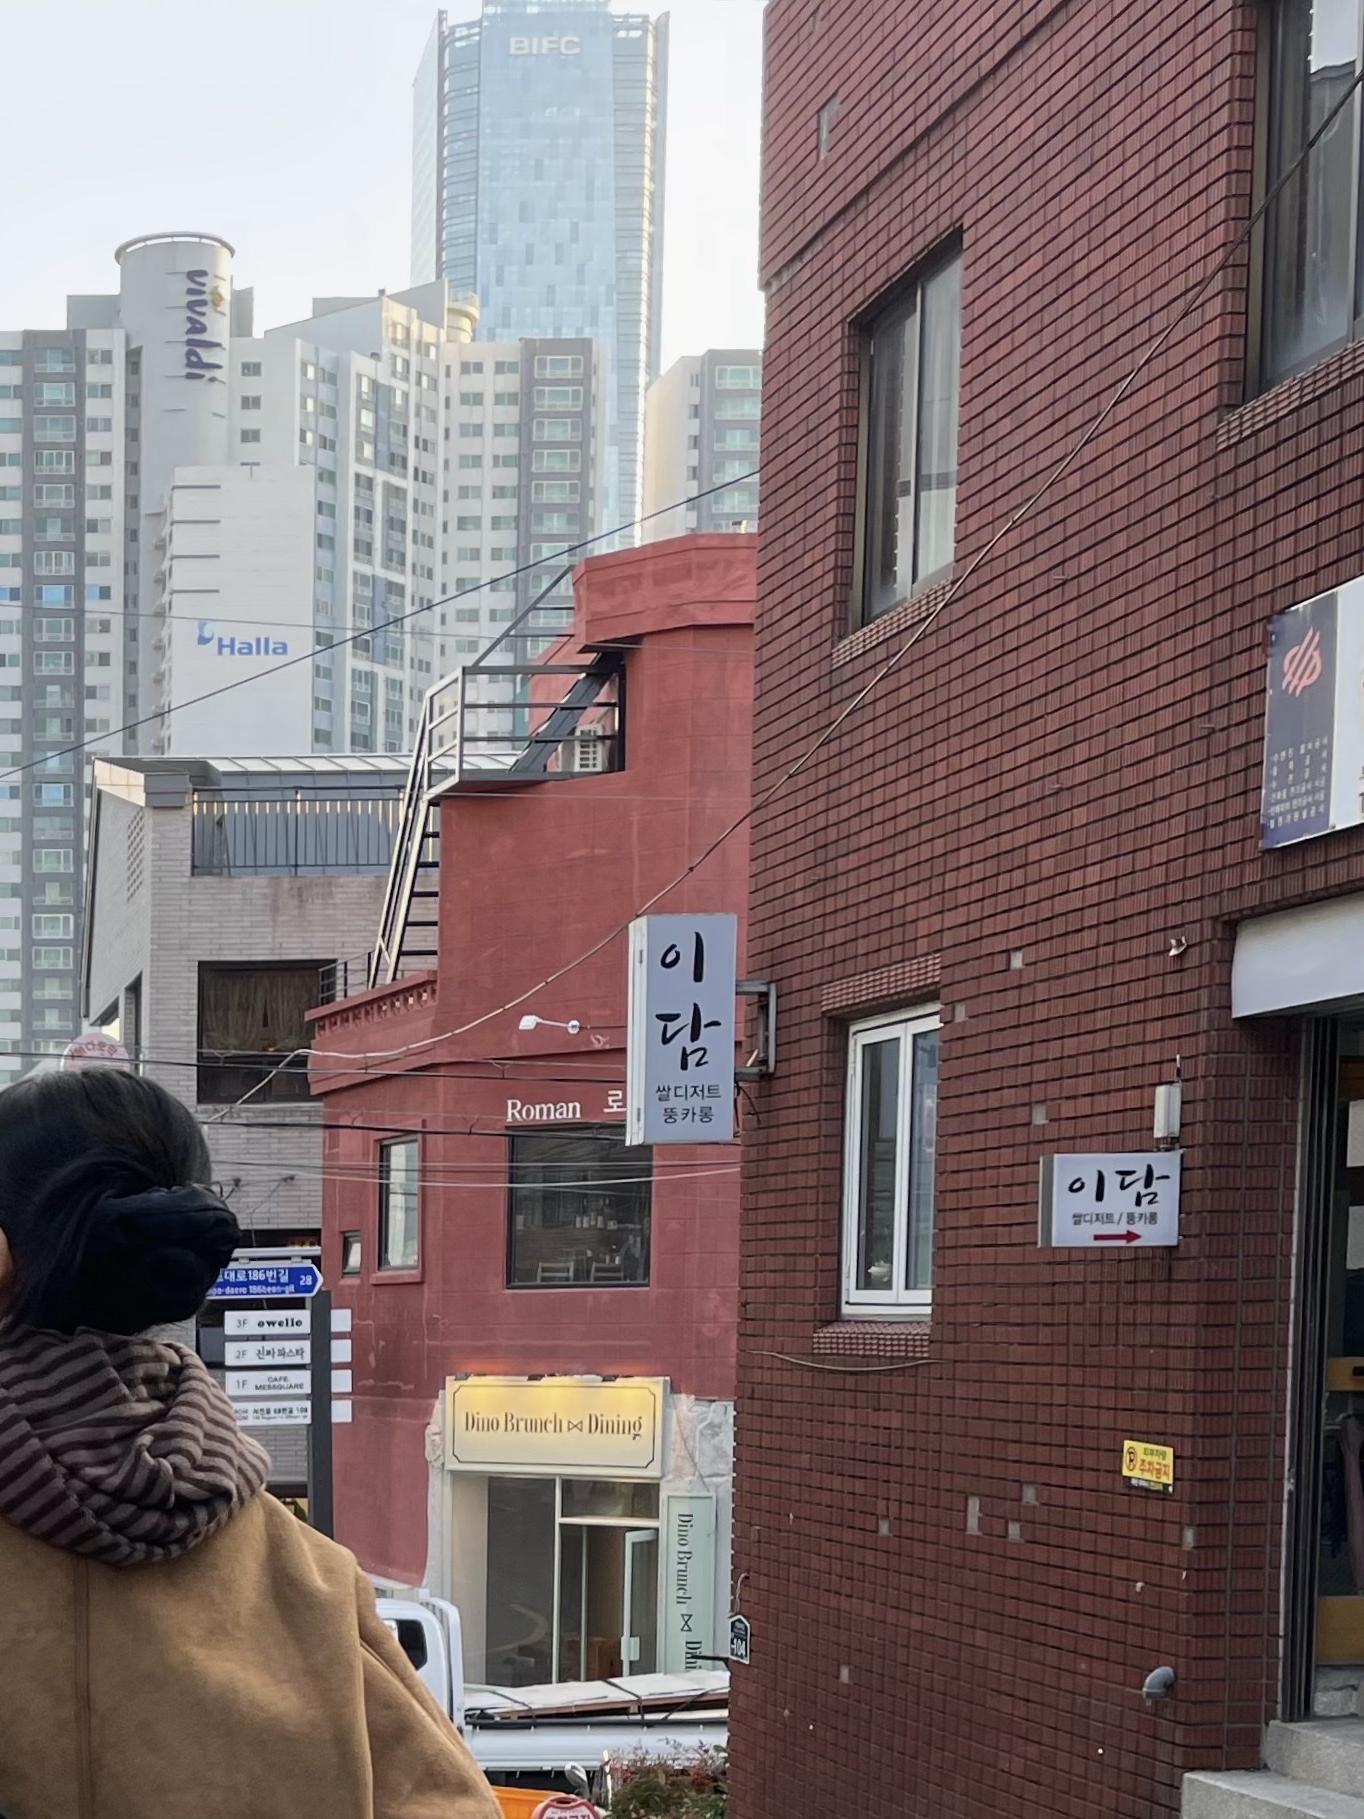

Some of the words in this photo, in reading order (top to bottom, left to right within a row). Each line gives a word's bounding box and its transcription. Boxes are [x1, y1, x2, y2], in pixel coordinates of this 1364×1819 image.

[509, 35, 581, 56] BIFC
[185, 269, 224, 382] vivaldi
[217, 636, 288, 656] Halla
[655, 931, 722, 1071] 이담
[655, 1083, 722, 1101] 쌀디저트
[506, 1099, 581, 1121] Roman
[663, 1106, 714, 1124] 뚱카롱
[1068, 1163, 1170, 1207] 이담
[1072, 1212, 1115, 1226] 쌀디저트
[299, 1274, 313, 1286] 28
[236, 1319, 248, 1328] 3F
[235, 1349, 247, 1359] 2F
[236, 1379, 247, 1390] 1F
[465, 1411, 500, 1432] Dino
[503, 1411, 563, 1433] Brunch
[588, 1413, 642, 1440] Dining
[677, 1513, 693, 1547] Dino
[676, 1551, 693, 1604] Brunch
